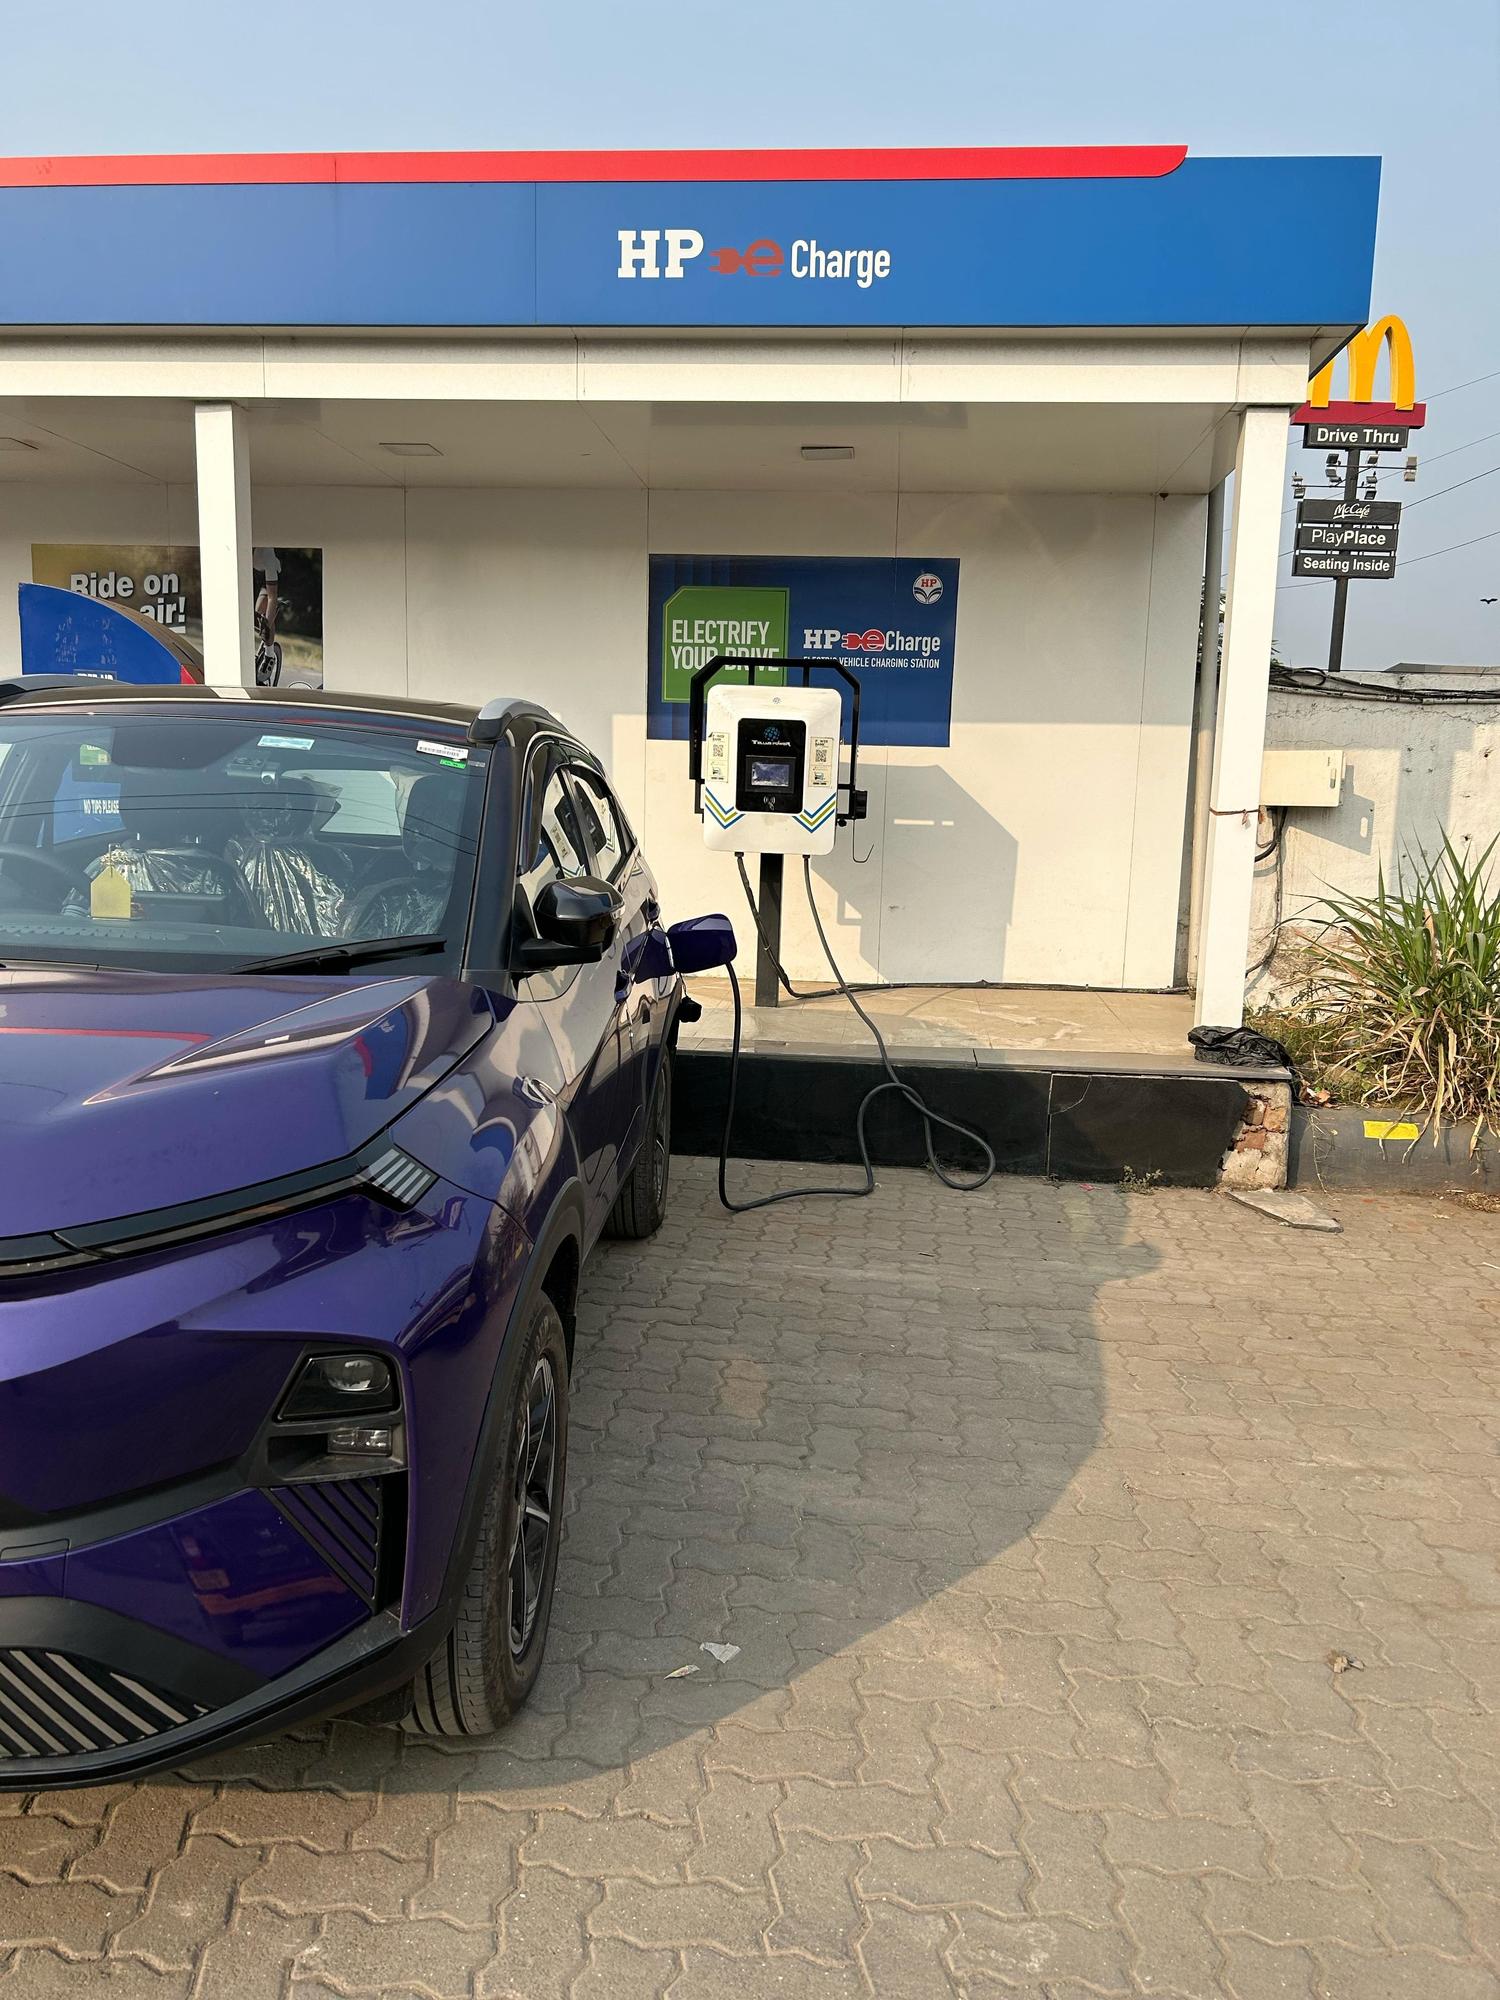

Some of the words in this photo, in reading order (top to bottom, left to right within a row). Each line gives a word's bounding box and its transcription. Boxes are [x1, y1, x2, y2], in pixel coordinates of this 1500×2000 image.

[617, 229, 704, 278] HP
[791, 239, 891, 288] Charge
[1317, 428, 1358, 443] Drive
[1363, 429, 1400, 444] Thru
[1311, 529, 1386, 547] PlayPlace
[1303, 557, 1349, 573] Seating
[1353, 558, 1390, 572] Inside
[70, 571, 134, 599] Ride
[143, 573, 179, 596] on
[921, 578, 937, 588] HP
[140, 596, 186, 624] air!
[672, 619, 770, 645] ELECTRIFY
[803, 629, 841, 650] HP
[885, 630, 941, 657] Charge
[839, 656, 869, 668] VEHICLE
[870, 657, 909, 669] CHARGING
[910, 658, 940, 669] STATION
